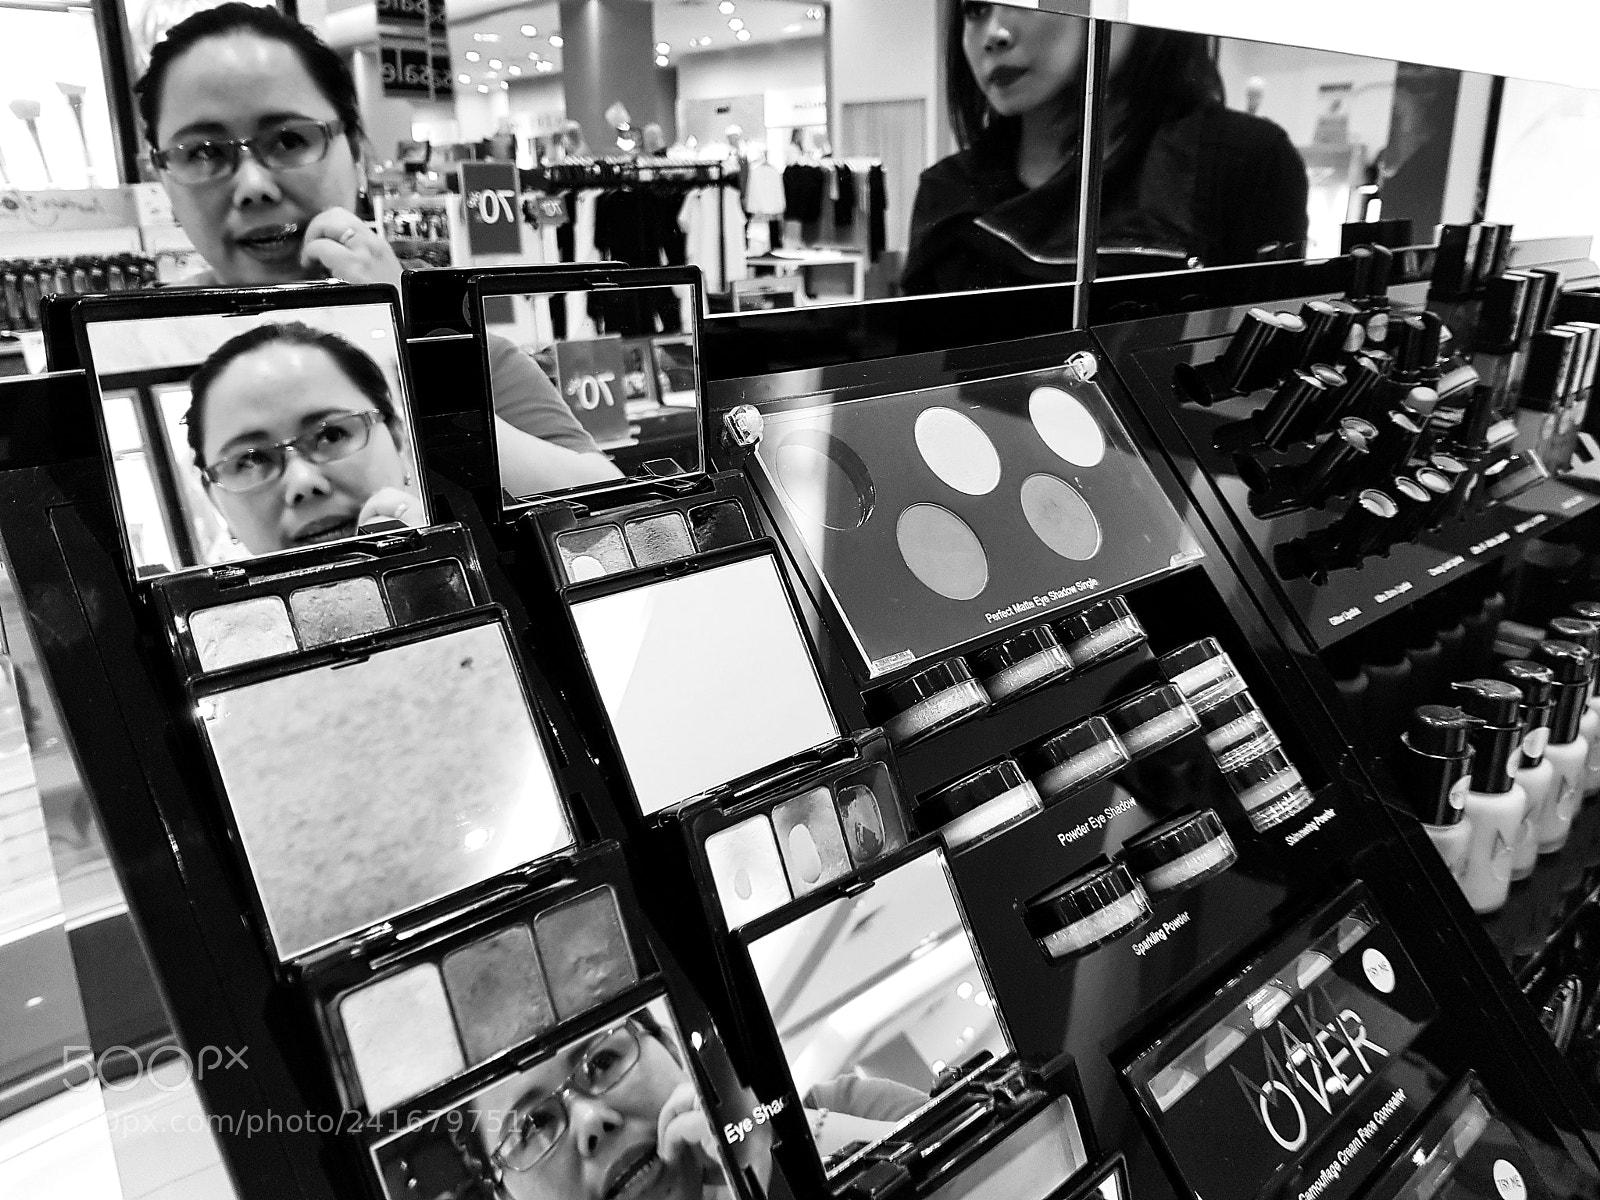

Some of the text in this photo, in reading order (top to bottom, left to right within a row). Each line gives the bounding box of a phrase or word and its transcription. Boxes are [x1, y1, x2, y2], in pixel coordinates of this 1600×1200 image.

[984, 577, 1098, 624] Perfect Matte Eye Shadow Single
[1057, 796, 1138, 847] Powder Eye Shadow
[1131, 911, 1191, 956] Sparkling Powder
[1260, 1008, 1391, 1153] OVER
[723, 1117, 754, 1145] Eye
[1336, 1136, 1364, 1166] Cream
[1356, 1119, 1379, 1144] Face
[1372, 1087, 1407, 1125] Concealer
